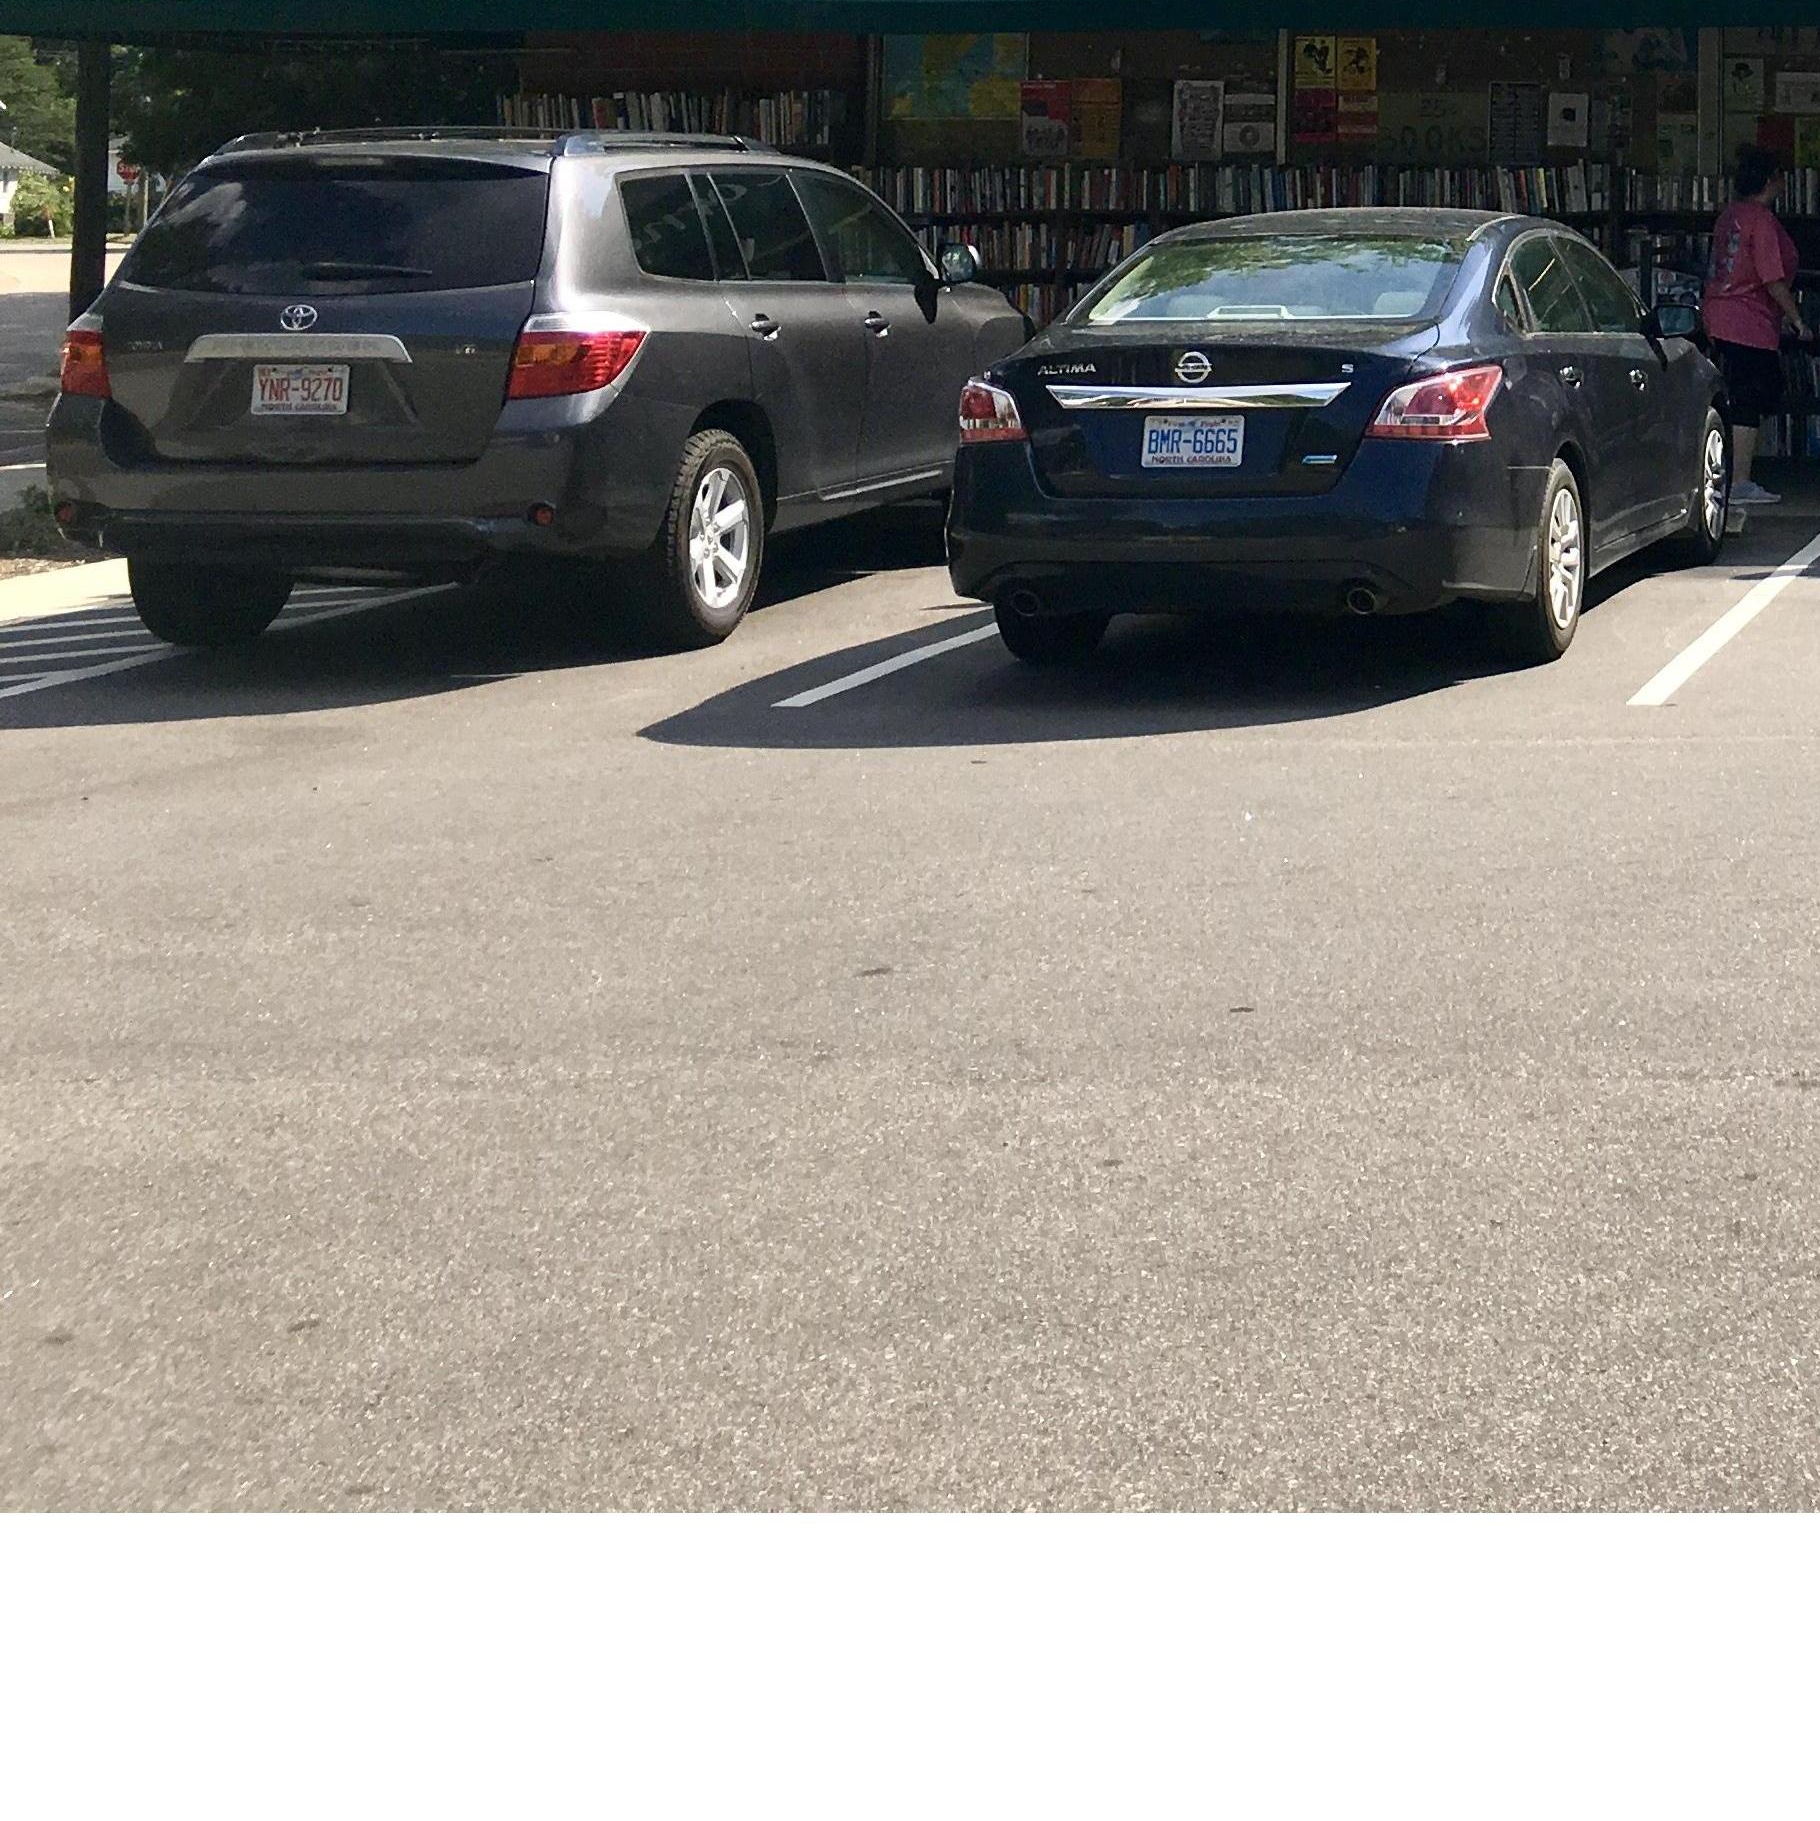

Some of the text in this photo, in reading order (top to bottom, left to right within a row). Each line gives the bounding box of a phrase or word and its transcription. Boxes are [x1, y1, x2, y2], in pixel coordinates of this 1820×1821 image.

[1037, 363, 1354, 375] ALTIMA S
[259, 377, 344, 402] YNR-9270
[1148, 428, 1239, 454] BMR-6665
[1152, 455, 1232, 464] NORTH CAROLINA
